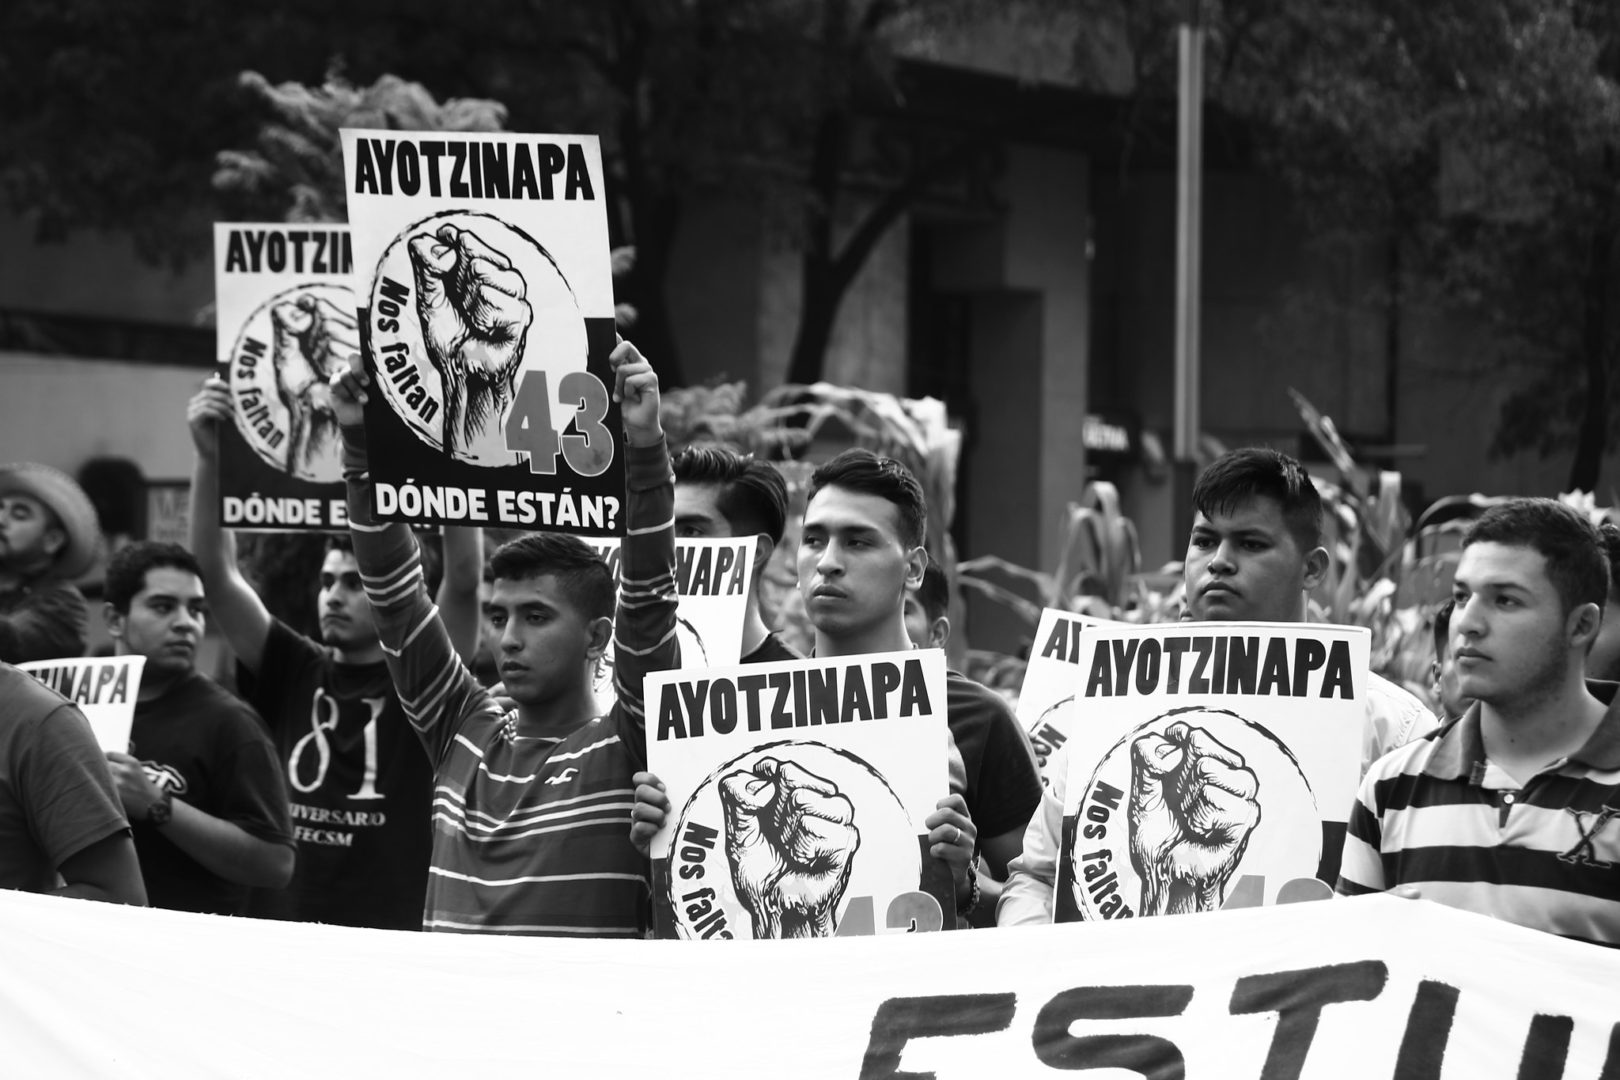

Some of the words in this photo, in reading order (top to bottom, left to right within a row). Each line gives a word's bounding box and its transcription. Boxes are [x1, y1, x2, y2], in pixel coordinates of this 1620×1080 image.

[355, 138, 595, 200] AYOTZINAPA
[377, 276, 410, 334] Nos
[237, 337, 268, 380] Nos
[380, 342, 439, 424] faltan
[238, 387, 285, 449] faltan
[505, 369, 615, 477] 43
[222, 492, 322, 524] DÓNDE
[375, 478, 489, 520] DÓNDE
[497, 487, 620, 530] ESTÁN?
[1085, 636, 1355, 700] AYOTZINAPA
[656, 659, 932, 741] AYOTZINAPA
[1083, 780, 1125, 840] Nos
[679, 821, 719, 880] Nos
